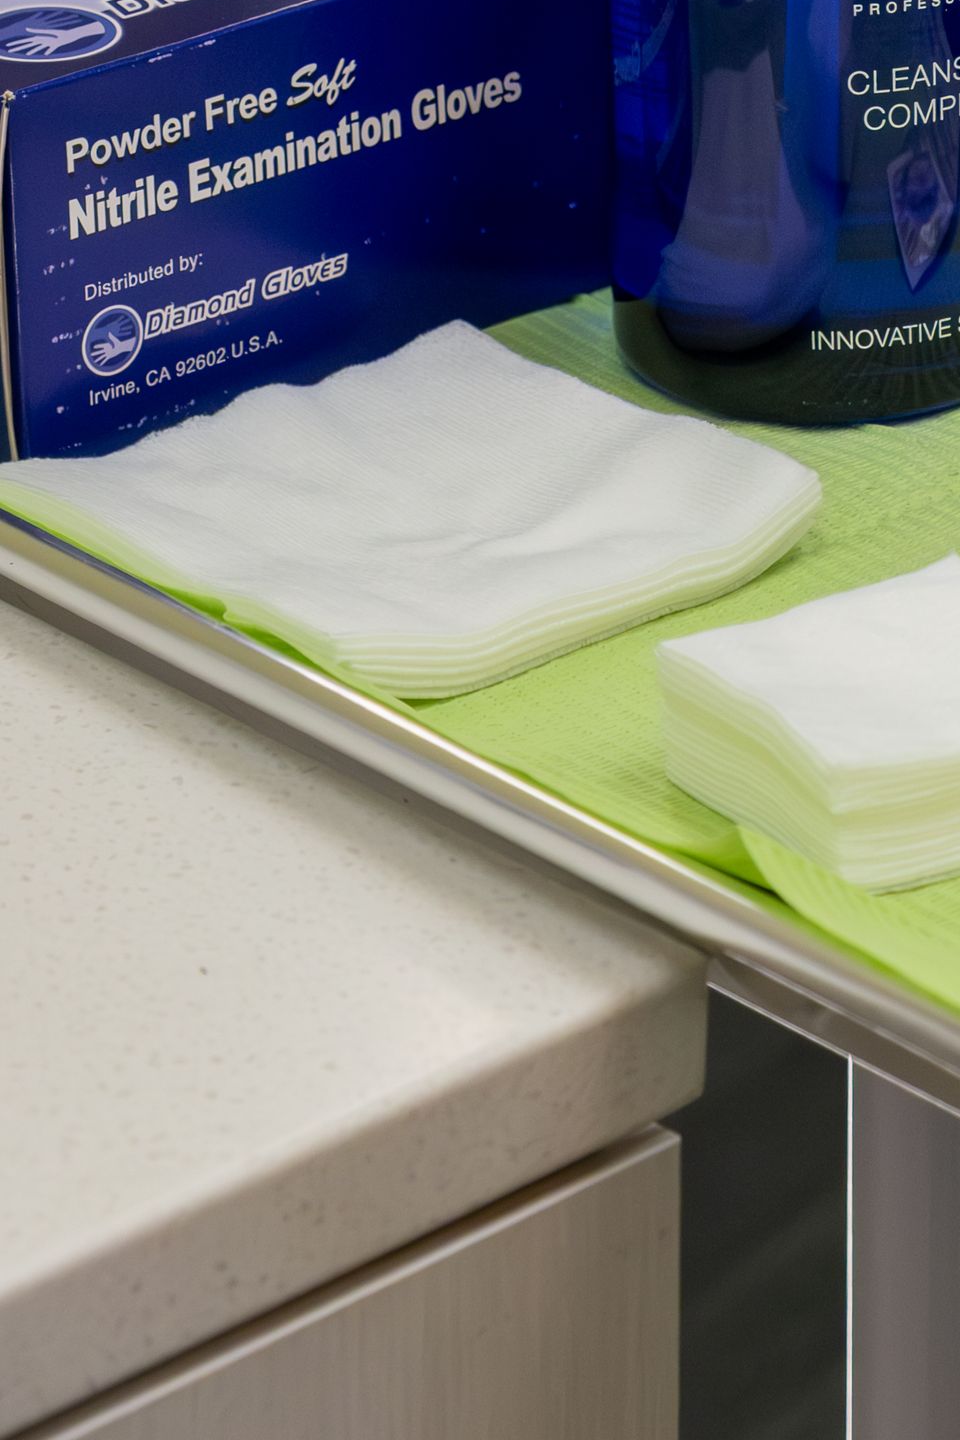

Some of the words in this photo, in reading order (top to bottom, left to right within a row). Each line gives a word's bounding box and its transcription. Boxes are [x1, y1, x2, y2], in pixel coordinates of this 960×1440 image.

[66, 109, 196, 174] Powder
[205, 86, 278, 131] Free
[286, 57, 357, 107] Soft
[68, 176, 178, 240] Nitrile
[189, 105, 402, 204] Examination
[411, 70, 523, 131] Gloves
[84, 257, 175, 301] Distributed
[179, 251, 204, 282] by:
[143, 279, 256, 340] Diamond
[261, 253, 349, 301] Gloves
[88, 378, 141, 407] Irvine,
[145, 365, 173, 389] CA
[175, 347, 228, 379] 92602
[231, 332, 284, 360] U.S.A.
[810, 317, 952, 351] INNOVATIVE
